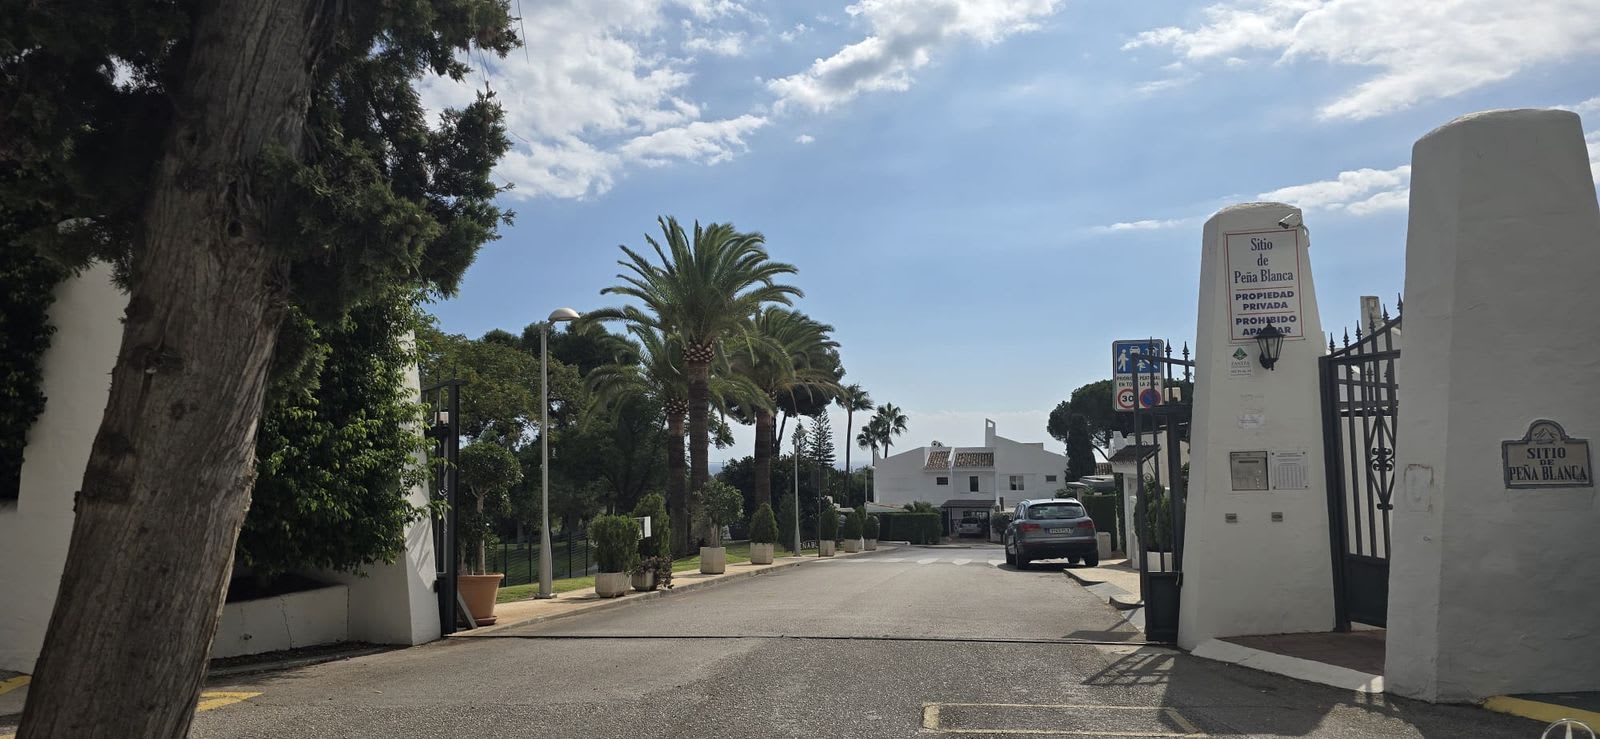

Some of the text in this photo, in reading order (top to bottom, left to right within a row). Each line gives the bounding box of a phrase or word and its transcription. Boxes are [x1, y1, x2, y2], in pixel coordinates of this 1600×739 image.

[1250, 237, 1273, 251] Sitio
[1257, 254, 1269, 266] de
[1234, 269, 1294, 283] Peña Blanca
[1235, 290, 1295, 301] PROPIEDAD
[1242, 301, 1288, 311] PRIVADA
[1242, 327, 1292, 336] APAAR
[1526, 447, 1566, 459] SITIO
[1509, 464, 1588, 481] PEÑA BLANCA
